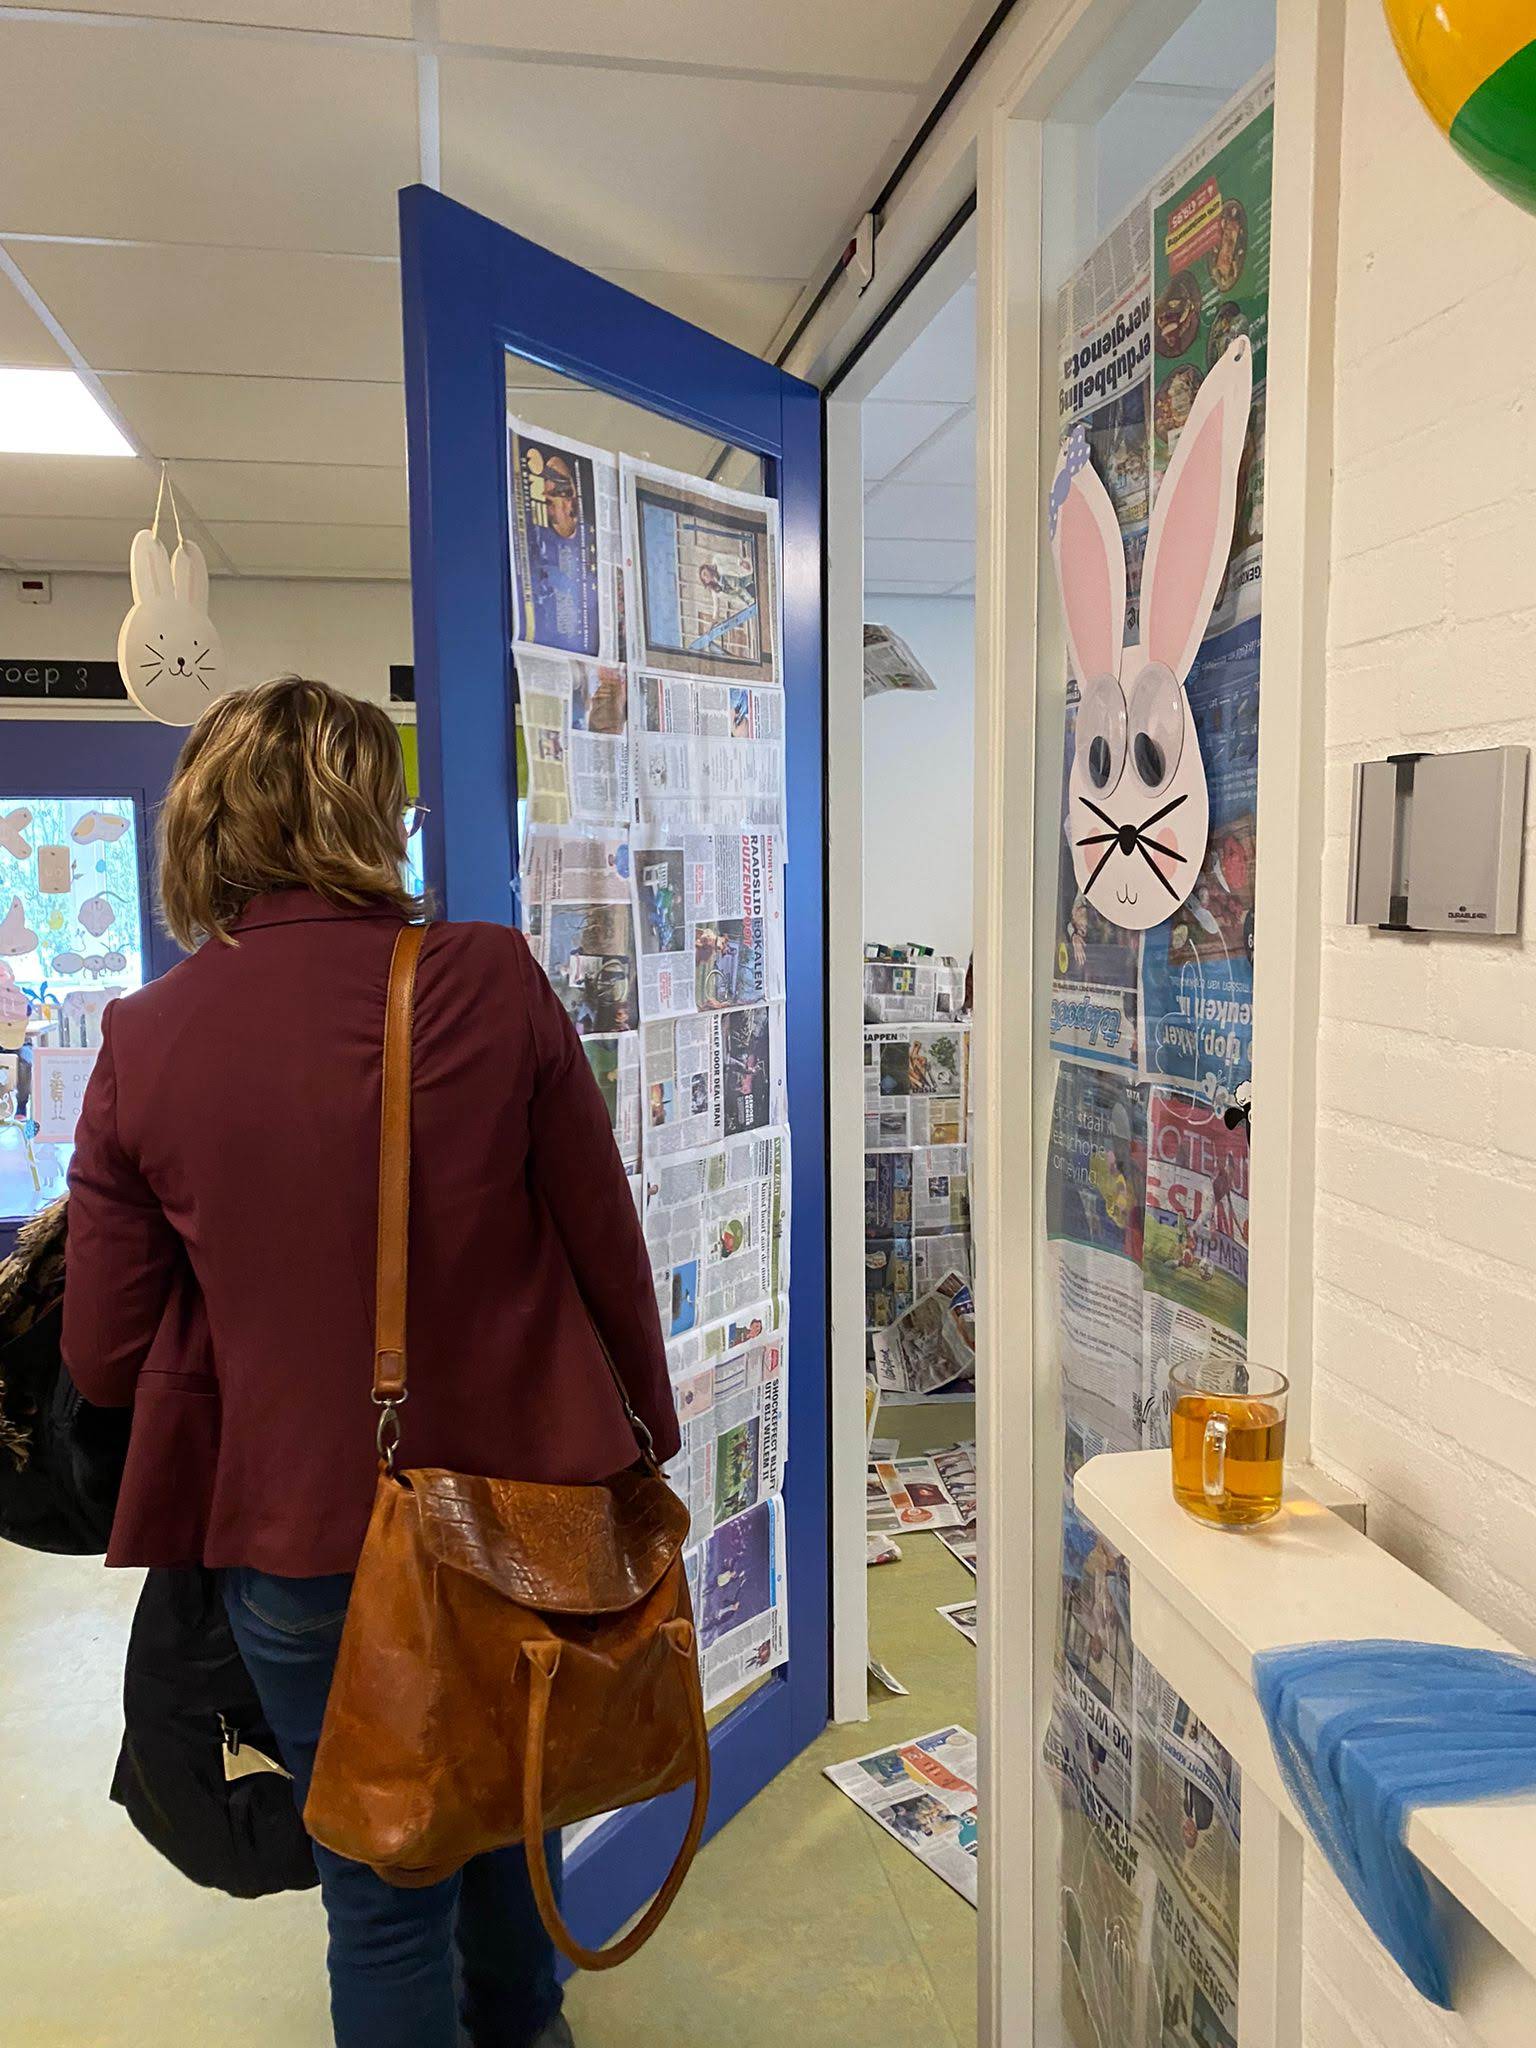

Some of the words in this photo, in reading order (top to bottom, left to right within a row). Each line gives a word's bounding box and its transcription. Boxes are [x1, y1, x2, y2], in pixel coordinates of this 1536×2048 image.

[75, 667, 88, 692] 3
[741, 834, 754, 948] DUIZENDPOOT
[750, 835, 762, 915] RAADSLID
[753, 918, 764, 991] LOKALEN
[712, 1014, 720, 1049] STREEP
[713, 1103, 721, 1127] IRAN
[764, 1381, 772, 1400] UIT
[763, 1404, 771, 1423] BIJ
[770, 1378, 780, 1452] SHOCKEFFECT
[762, 1425, 771, 1469] WILLEM
[762, 1471, 770, 1482] II
[768, 1456, 778, 1490] BLIJFT
